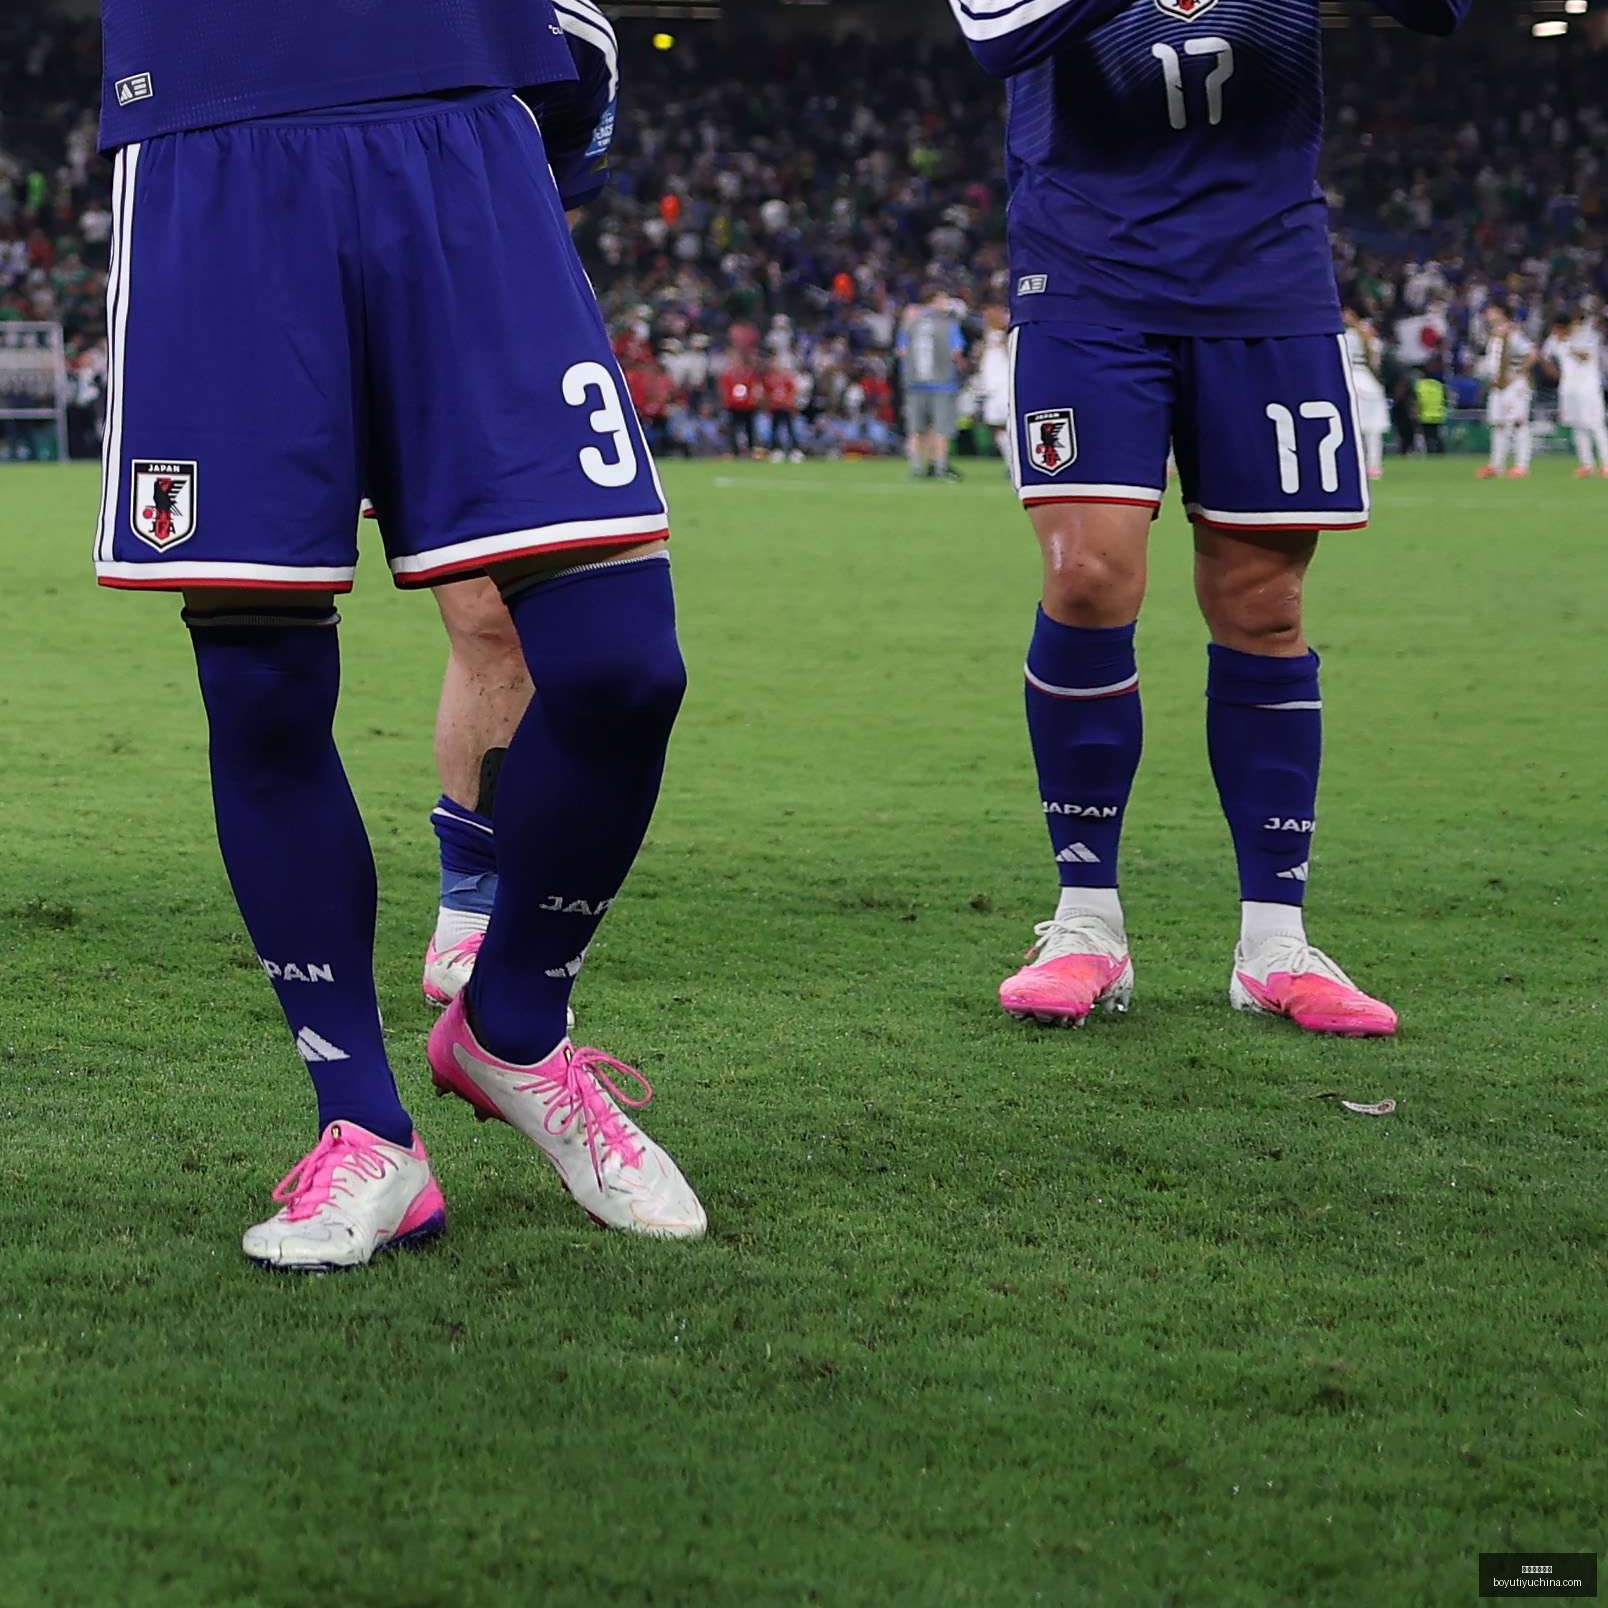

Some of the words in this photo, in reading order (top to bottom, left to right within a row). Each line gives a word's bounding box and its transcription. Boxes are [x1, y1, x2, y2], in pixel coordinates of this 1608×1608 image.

[1152, 37, 1233, 130] 17
[562, 361, 638, 488] 3
[1034, 412, 1059, 420] JAPAN
[1266, 401, 1344, 494] 17
[148, 464, 180, 473] JAPAN
[1043, 801, 1117, 818] JAPAN
[259, 955, 334, 982] PAN
